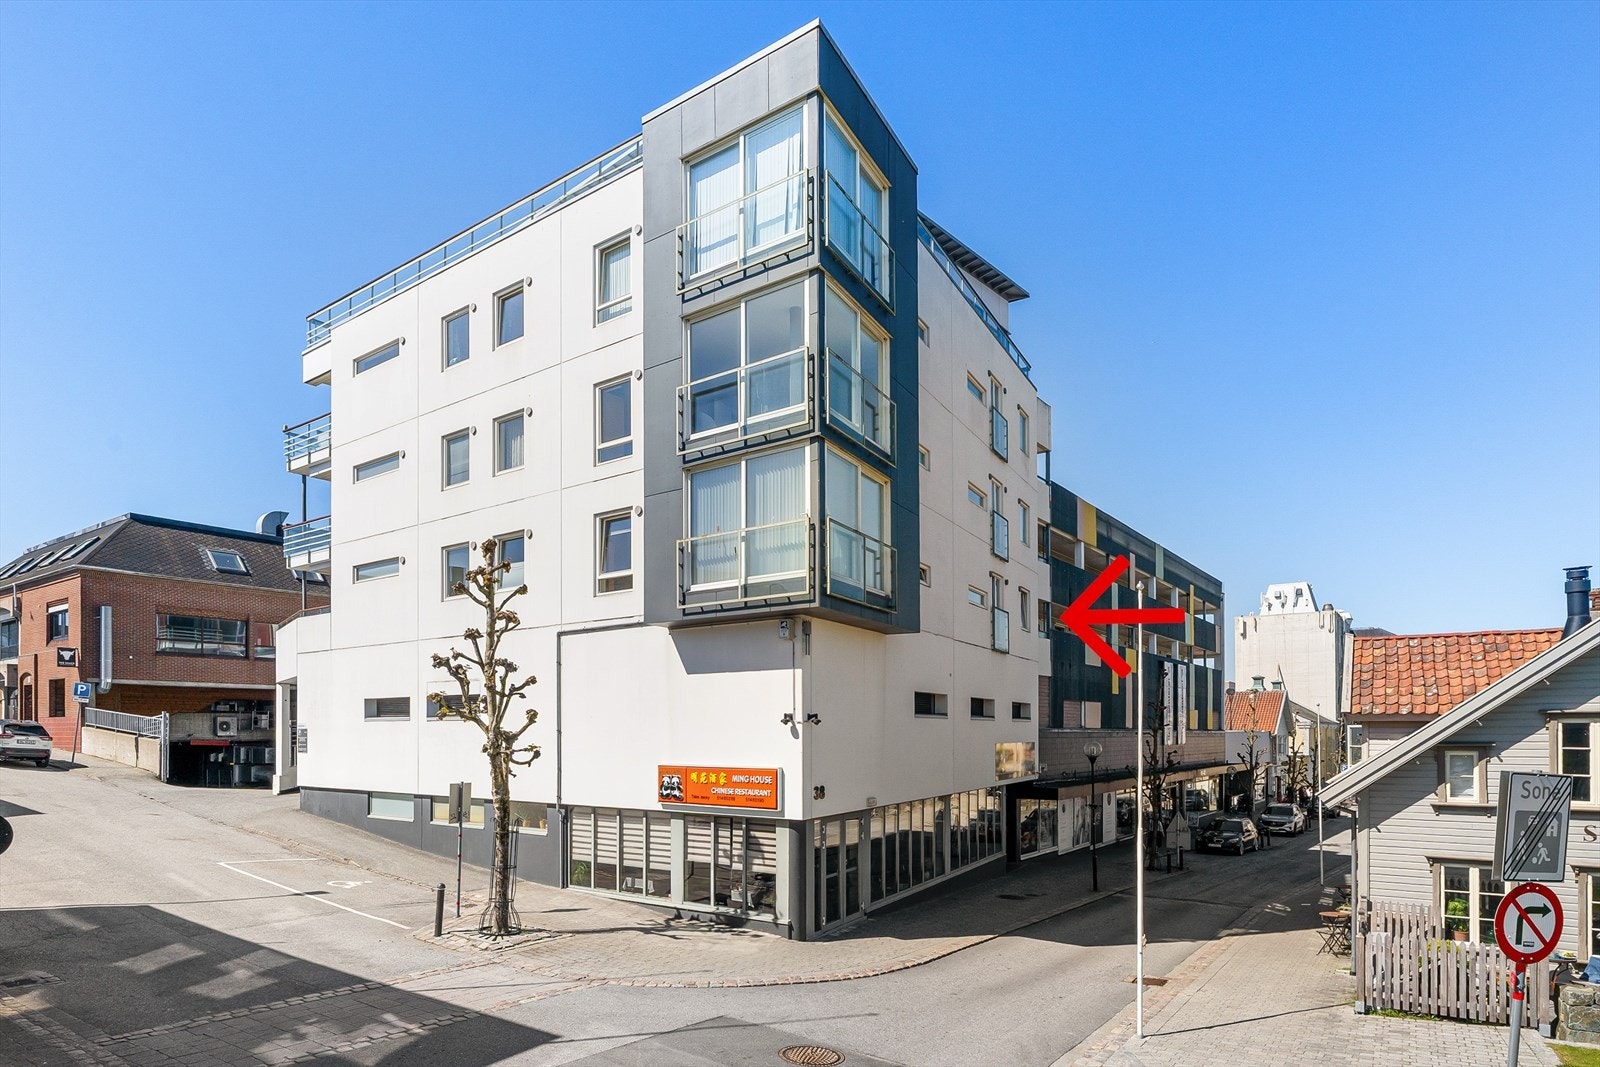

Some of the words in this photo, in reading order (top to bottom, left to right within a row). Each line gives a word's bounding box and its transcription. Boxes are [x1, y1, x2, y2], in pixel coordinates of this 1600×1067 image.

[77, 684, 87, 695] P
[731, 774, 749, 783] MING
[750, 775, 773, 784] HOUSE
[710, 787, 735, 795] CHINESE
[735, 788, 772, 797] RESTAURANT
[813, 785, 826, 800] 38
[1520, 780, 1560, 800] Sone
